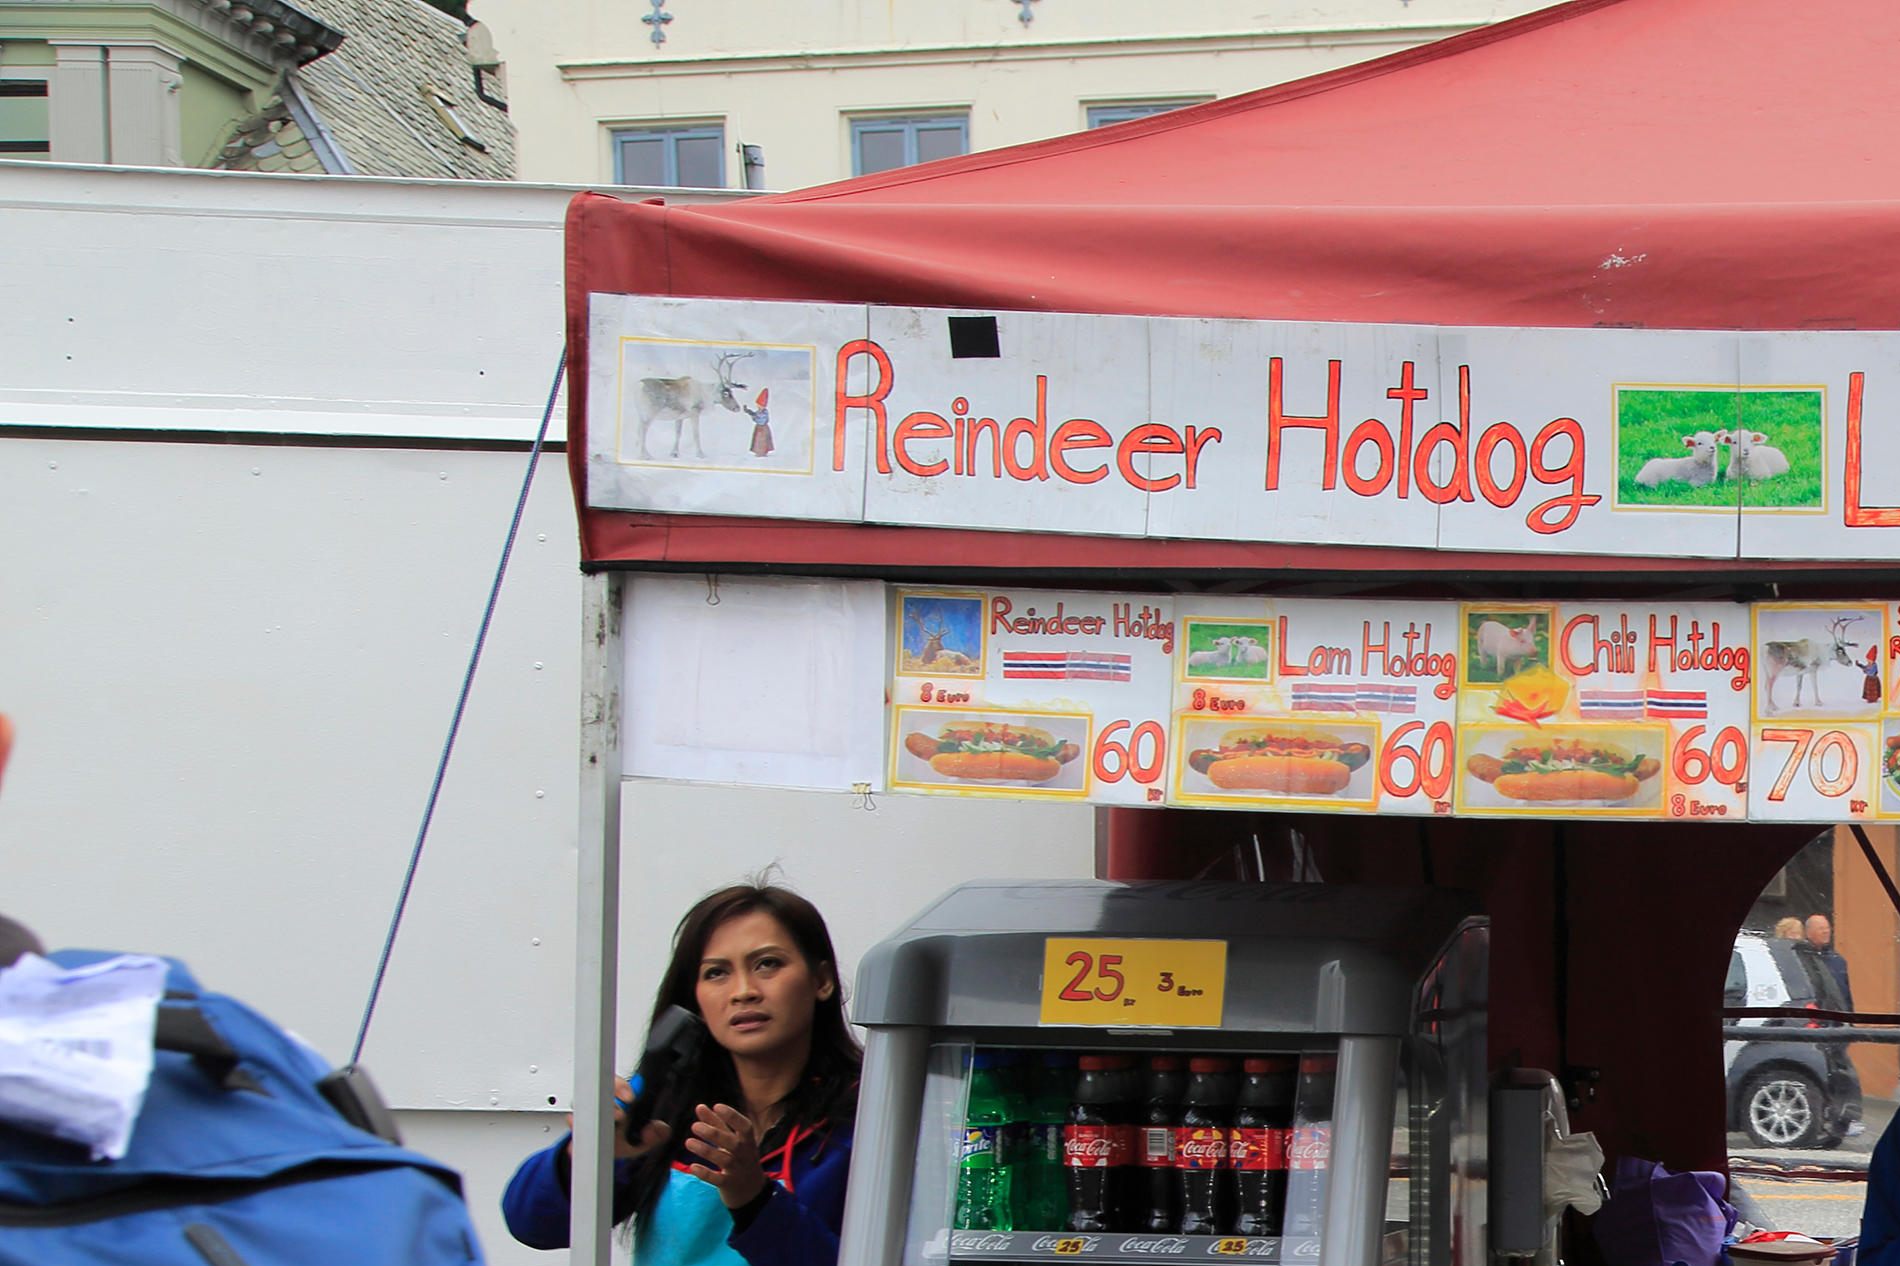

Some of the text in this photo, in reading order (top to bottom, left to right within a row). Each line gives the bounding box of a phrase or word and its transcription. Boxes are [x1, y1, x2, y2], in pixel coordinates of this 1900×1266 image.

[832, 339, 1601, 534] Reindeer Hotdog
[991, 597, 1174, 654] Reindeer Hotdog
[1279, 616, 1456, 699] Lam Hotdog
[1560, 614, 1750, 691] Chili Hotdog
[920, 683, 970, 704] 8 Euro
[1192, 688, 1245, 712] 8 Euro
[1092, 719, 1166, 784] 60
[1379, 720, 1453, 799] 60
[1671, 724, 1747, 786] 60
[1761, 728, 1858, 802] 70
[1671, 795, 1727, 817] 8 Euro
[1058, 951, 1125, 1001] 25
[1157, 972, 1174, 992] 3
[1057, 1240, 1081, 1253] 25
[1119, 1236, 1190, 1255] Coca-Cola
[1223, 1240, 1244, 1252] 25
